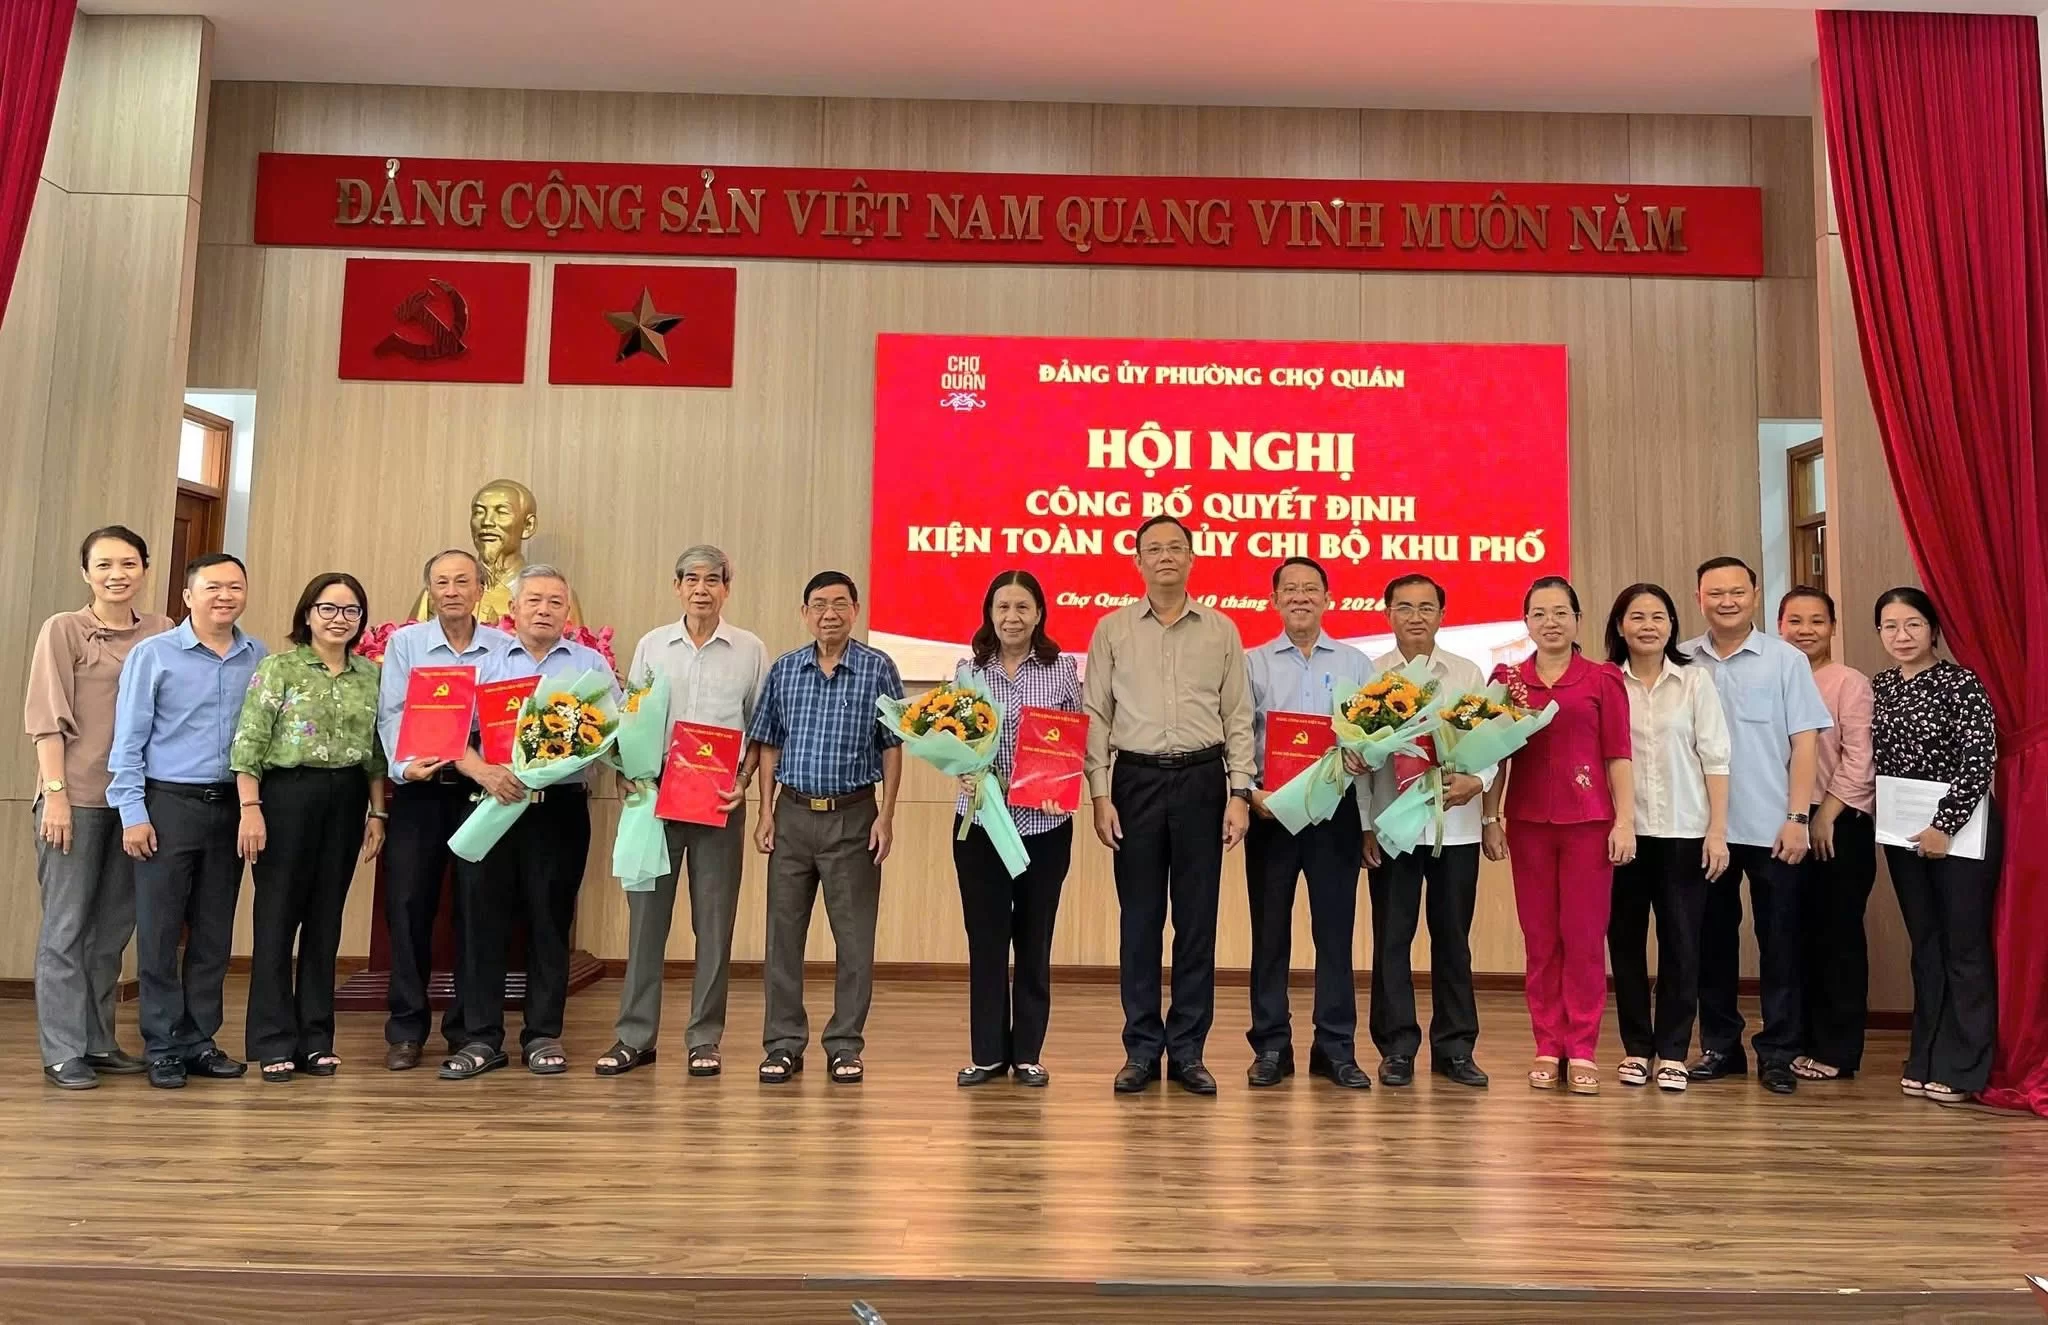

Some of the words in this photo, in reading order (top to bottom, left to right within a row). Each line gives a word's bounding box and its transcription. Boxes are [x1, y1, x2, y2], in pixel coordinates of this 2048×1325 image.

[334, 158, 487, 227] ĐẢNG
[501, 168, 645, 237] CỘNG
[659, 168, 766, 235] SẢN
[784, 176, 910, 245] VIỆT
[925, 193, 1044, 241] NAM
[1056, 196, 1234, 253] QUANG
[1248, 199, 1385, 248] VINH
[1401, 189, 1550, 251] MUÔN
[1567, 192, 1689, 253] NĂM
[941, 371, 986, 391] QUÁN
[947, 355, 981, 375] CHỢ
[1038, 359, 1110, 383] ĐẢNG
[1118, 360, 1150, 384] ỦY
[1156, 363, 1262, 386] PHƯỜNG
[1268, 367, 1324, 391] CHỢ
[1330, 366, 1405, 390] QUÁN
[1087, 420, 1193, 478] HỘI
[1208, 431, 1355, 482] NGHỊ
[1025, 485, 1132, 517] CÔNG
[1141, 484, 1194, 518] BỐ
[1202, 486, 1317, 523] QUYẾT
[1325, 495, 1416, 527] ĐỊNH
[907, 521, 992, 558] KIỆN
[1000, 524, 1103, 555] TOÀN
[1191, 522, 1240, 557] ỦY
[1247, 531, 1309, 558] CHI
[1319, 528, 1371, 565] BỘ
[1381, 534, 1460, 562] KHU
[1469, 529, 1546, 563] PHỐ
[1056, 592, 1092, 609] Chợ
[1220, 594, 1271, 612] tháng
